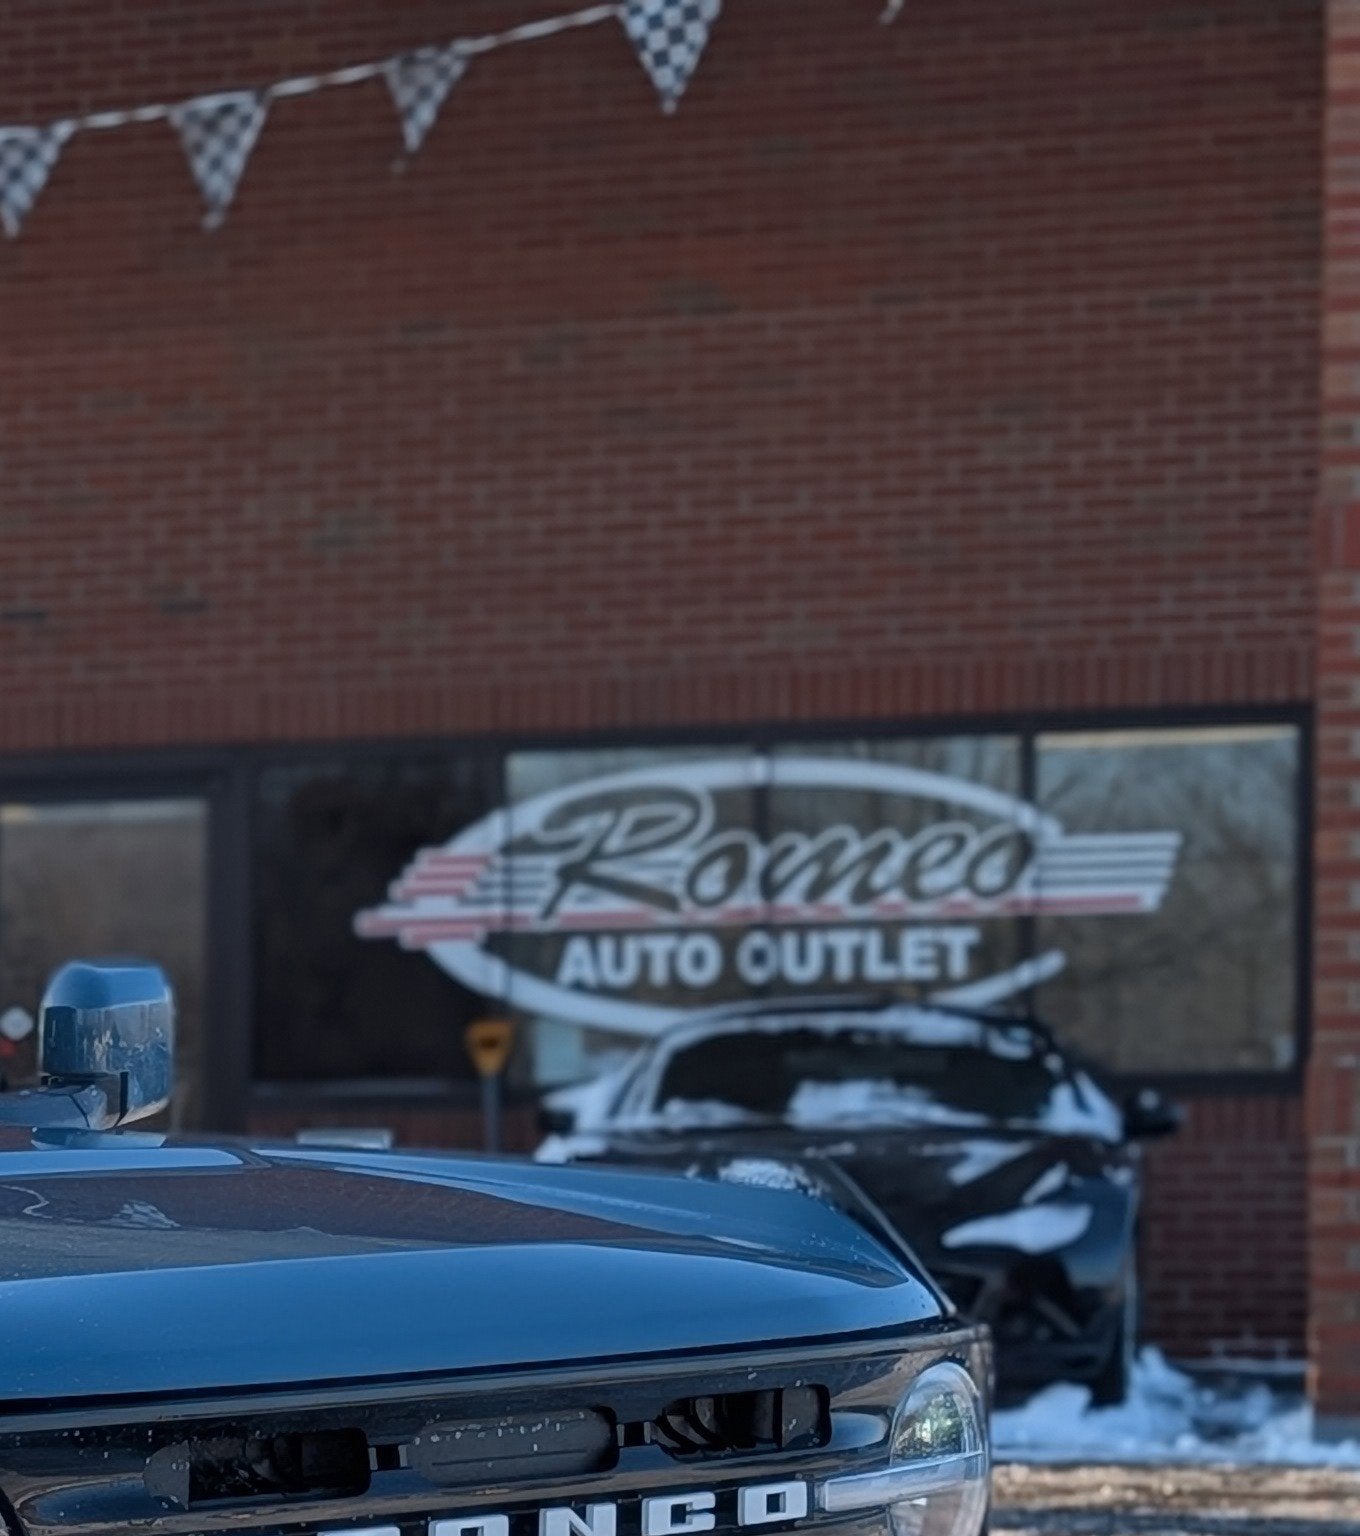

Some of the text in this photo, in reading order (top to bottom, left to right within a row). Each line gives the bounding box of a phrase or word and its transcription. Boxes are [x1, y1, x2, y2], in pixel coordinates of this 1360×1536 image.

[502, 783, 1039, 925] Romeo
[555, 925, 982, 989] AUTO OUTLET
